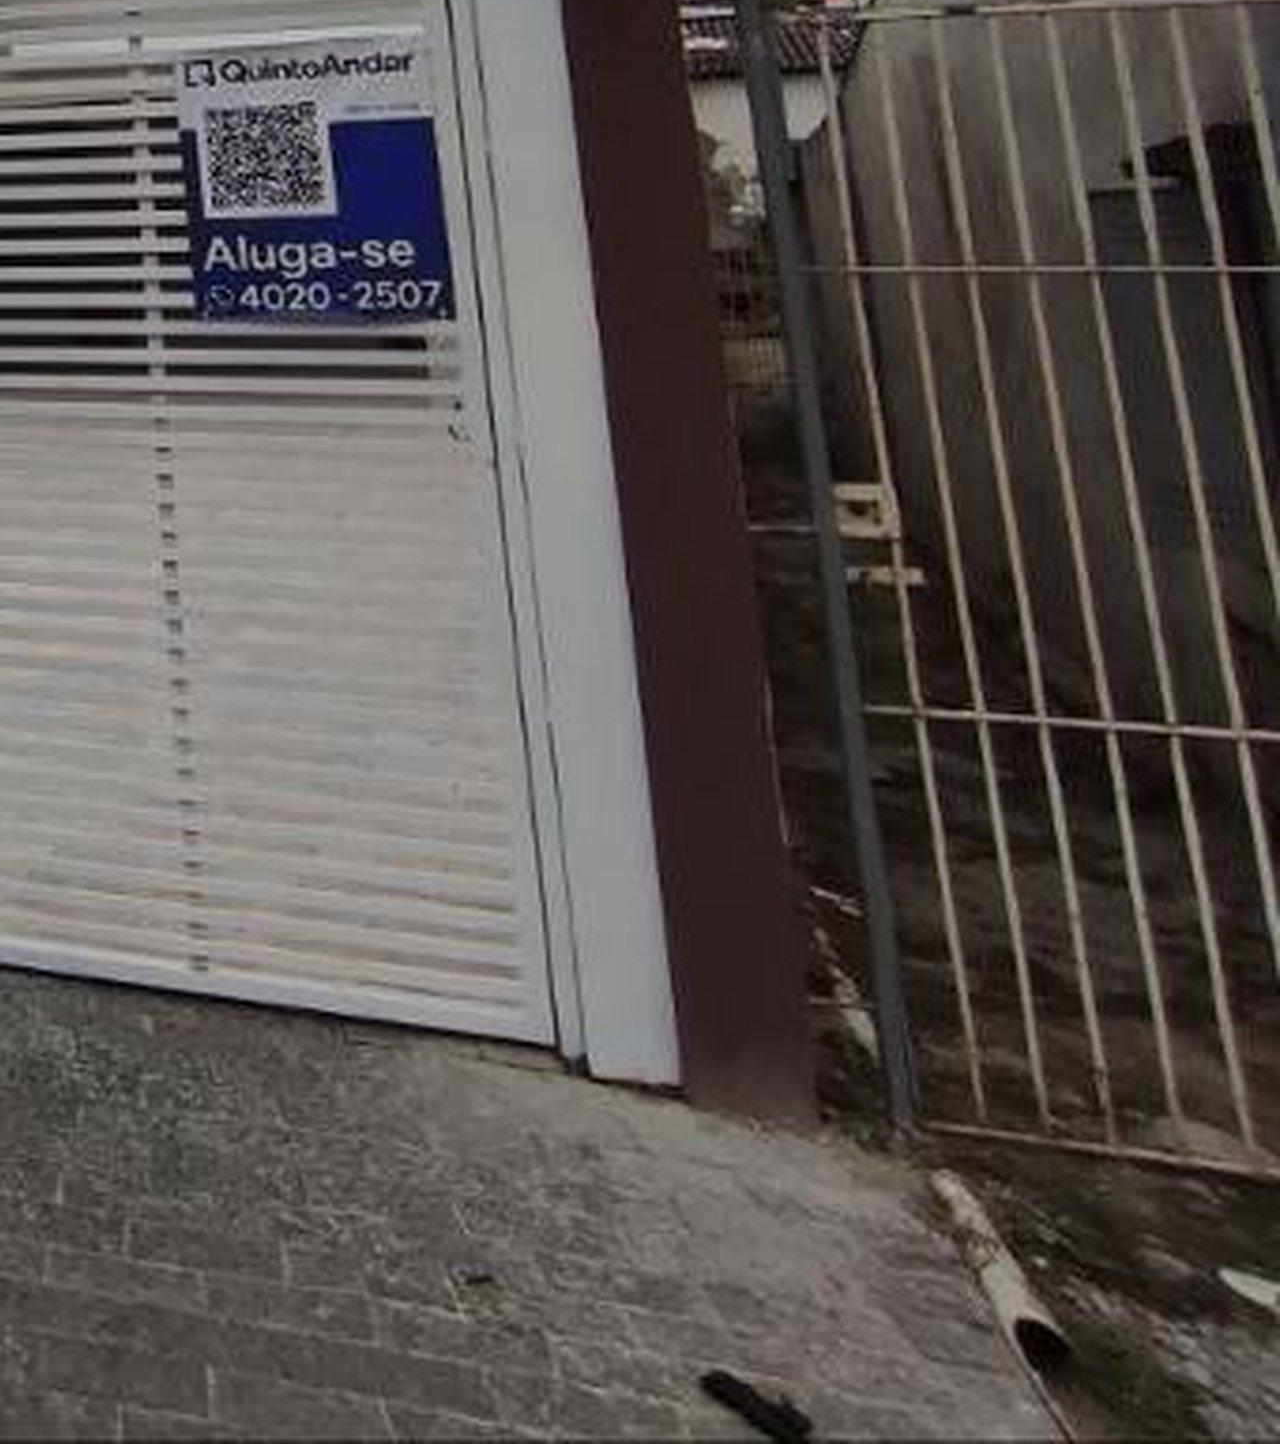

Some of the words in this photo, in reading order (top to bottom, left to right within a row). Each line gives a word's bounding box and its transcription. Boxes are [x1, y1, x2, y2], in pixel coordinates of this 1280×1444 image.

[220, 52, 414, 83] QuintoAndar
[203, 235, 415, 279] Aluga-se
[240, 280, 441, 311] 4020-2507
